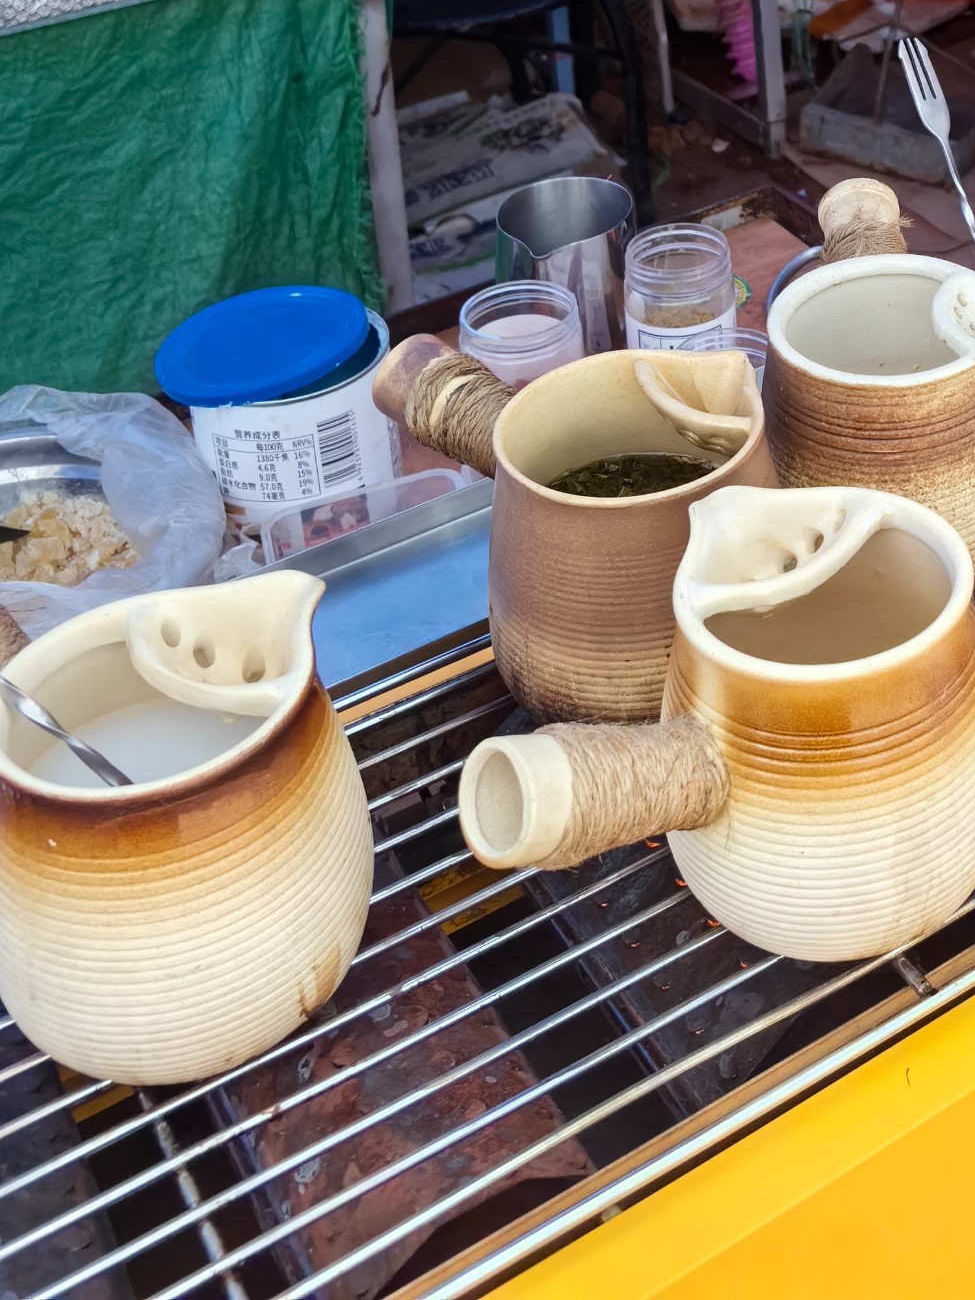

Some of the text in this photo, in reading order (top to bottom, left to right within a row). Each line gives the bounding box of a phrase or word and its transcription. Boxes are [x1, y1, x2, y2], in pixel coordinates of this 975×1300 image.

[234, 429, 281, 440] 营养成分表
[215, 437, 312, 451] 项目 每100克 NRV%
[217, 448, 310, 462] 能量 1380千焦 16%
[218, 458, 309, 472] 蛋白质 4.6克 8%
[259, 474, 278, 482] 9.0克
[297, 470, 312, 478] 15%
[221, 478, 314, 491] 碳水化合物 57.0克 19%
[262, 492, 286, 501] 74毫克
[301, 488, 313, 496] 4%
